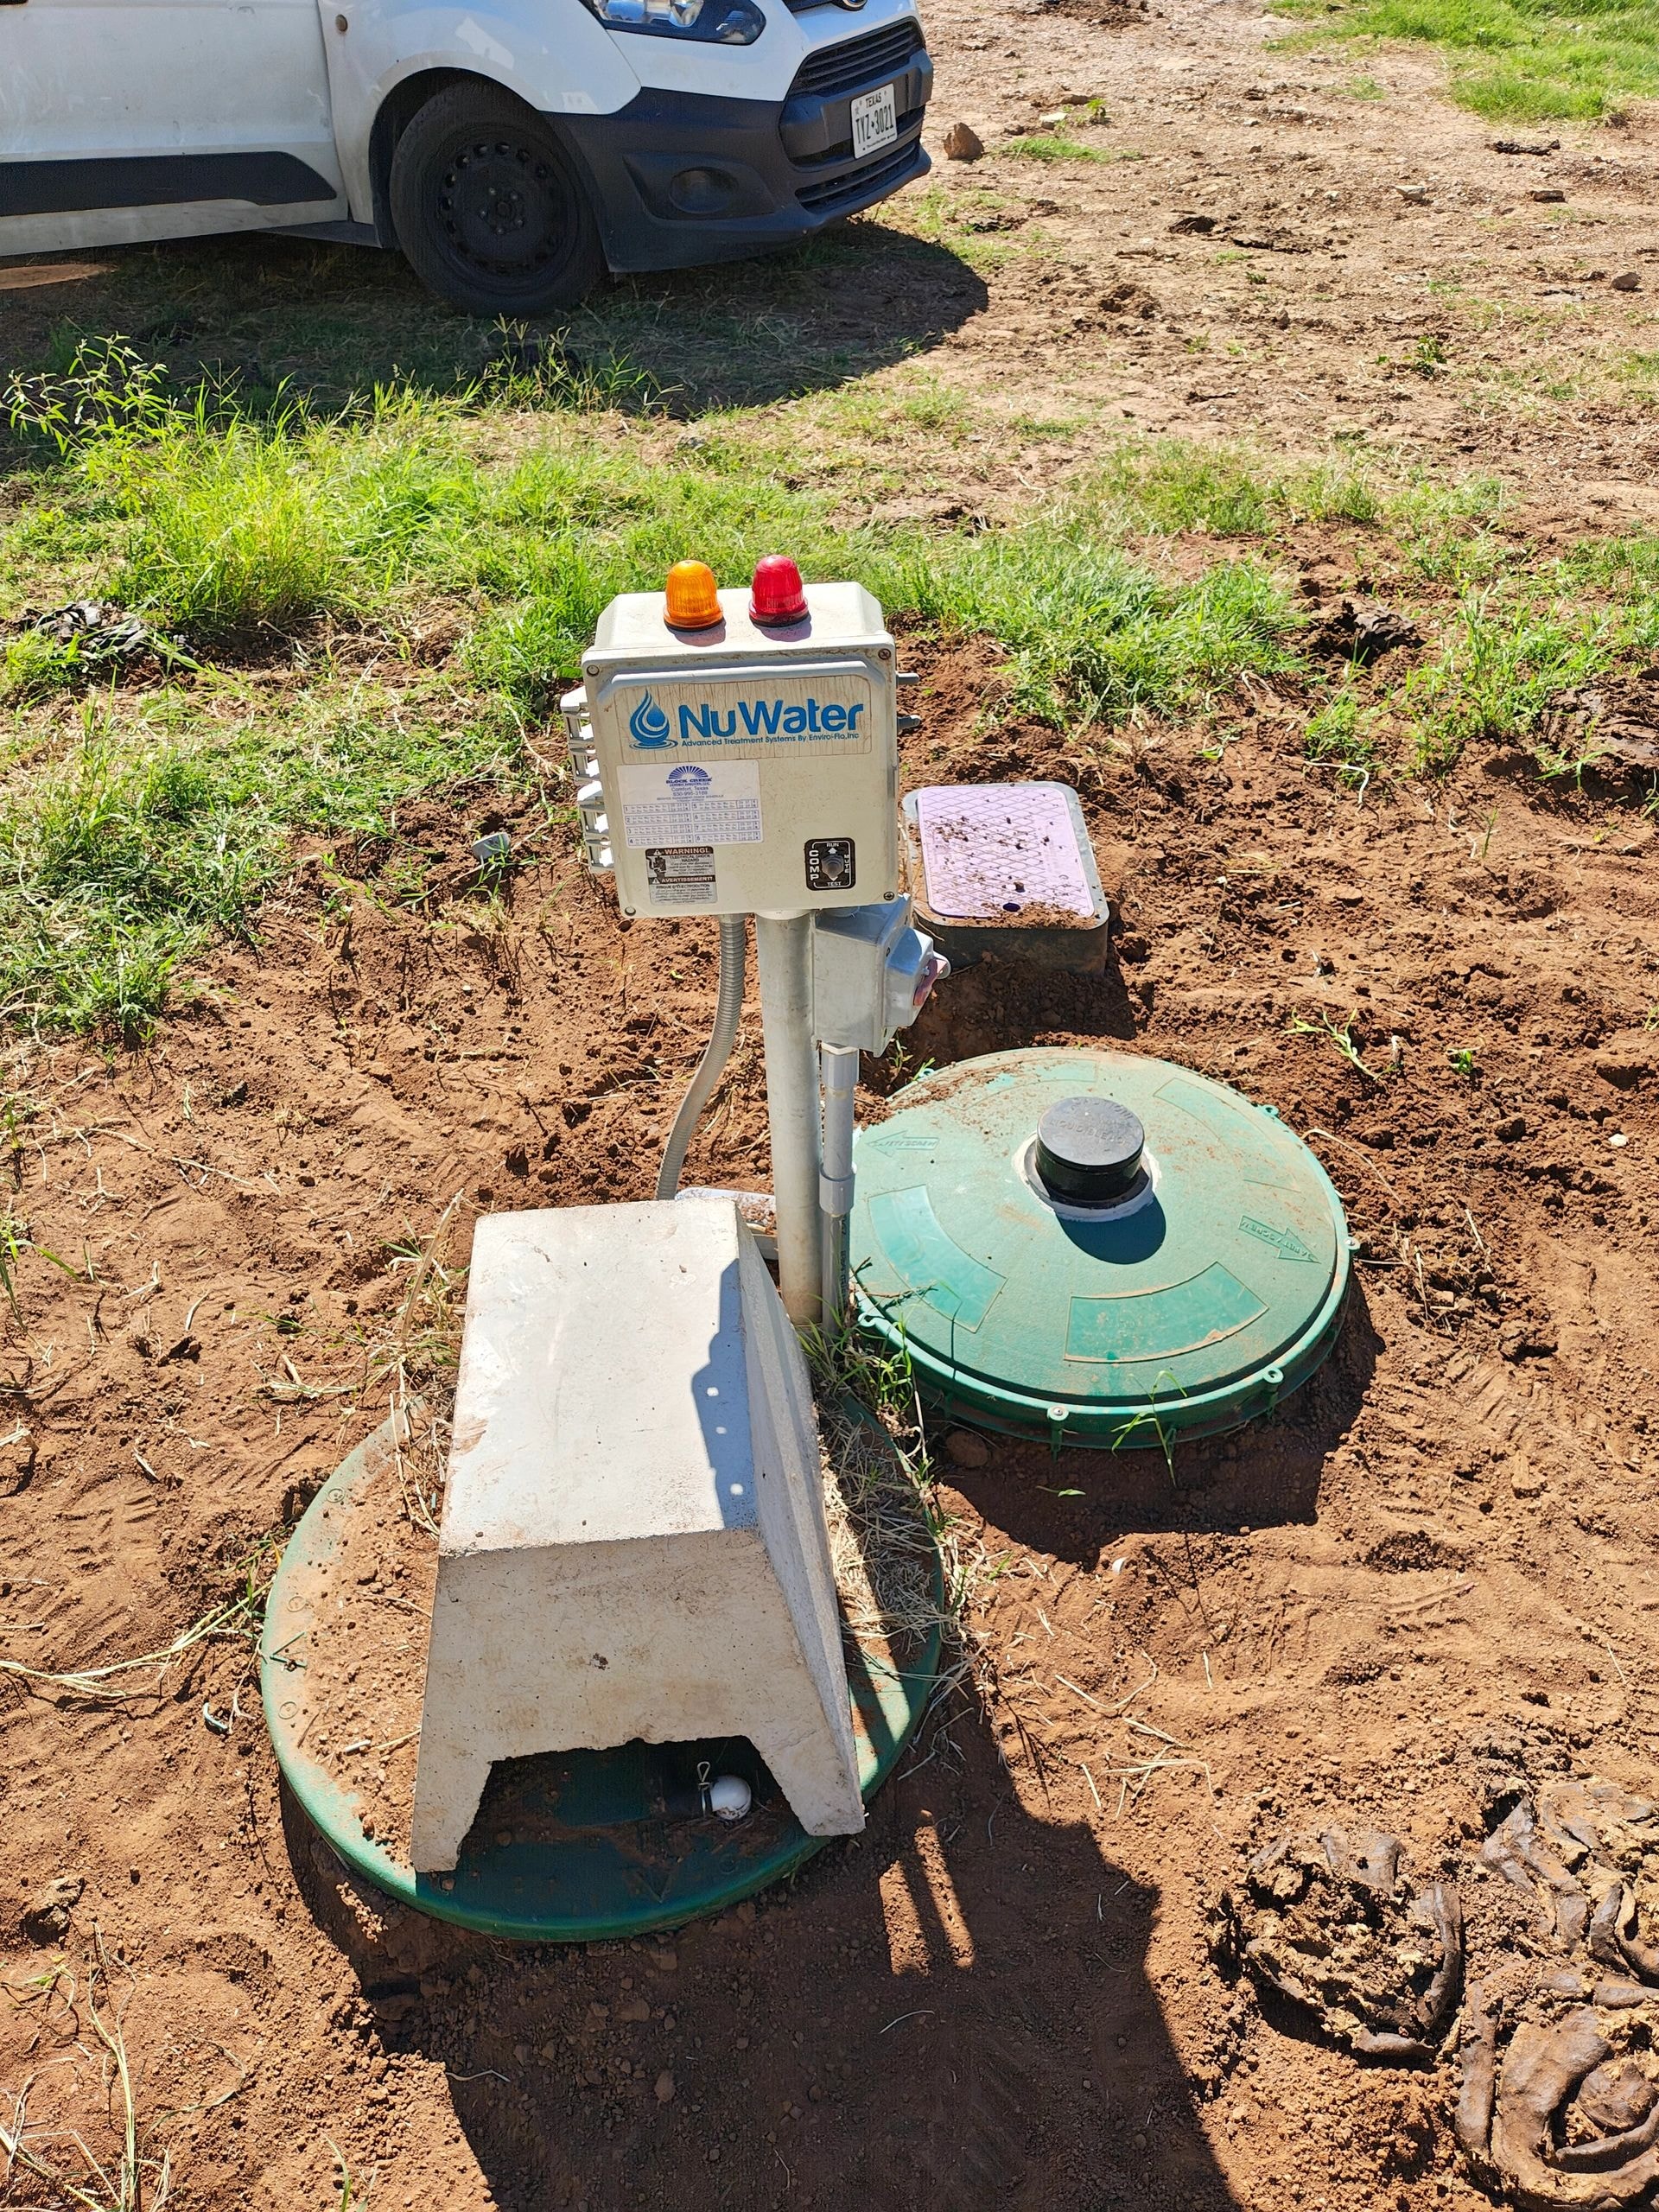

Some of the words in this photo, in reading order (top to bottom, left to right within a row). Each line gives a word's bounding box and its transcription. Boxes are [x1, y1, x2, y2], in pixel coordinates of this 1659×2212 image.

[866, 92, 881, 109] TEXAS
[855, 113, 871, 144] TYZ
[874, 104, 894, 135] 3021
[766, 734, 796, 744] Systems
[809, 850, 819, 880] COMP
